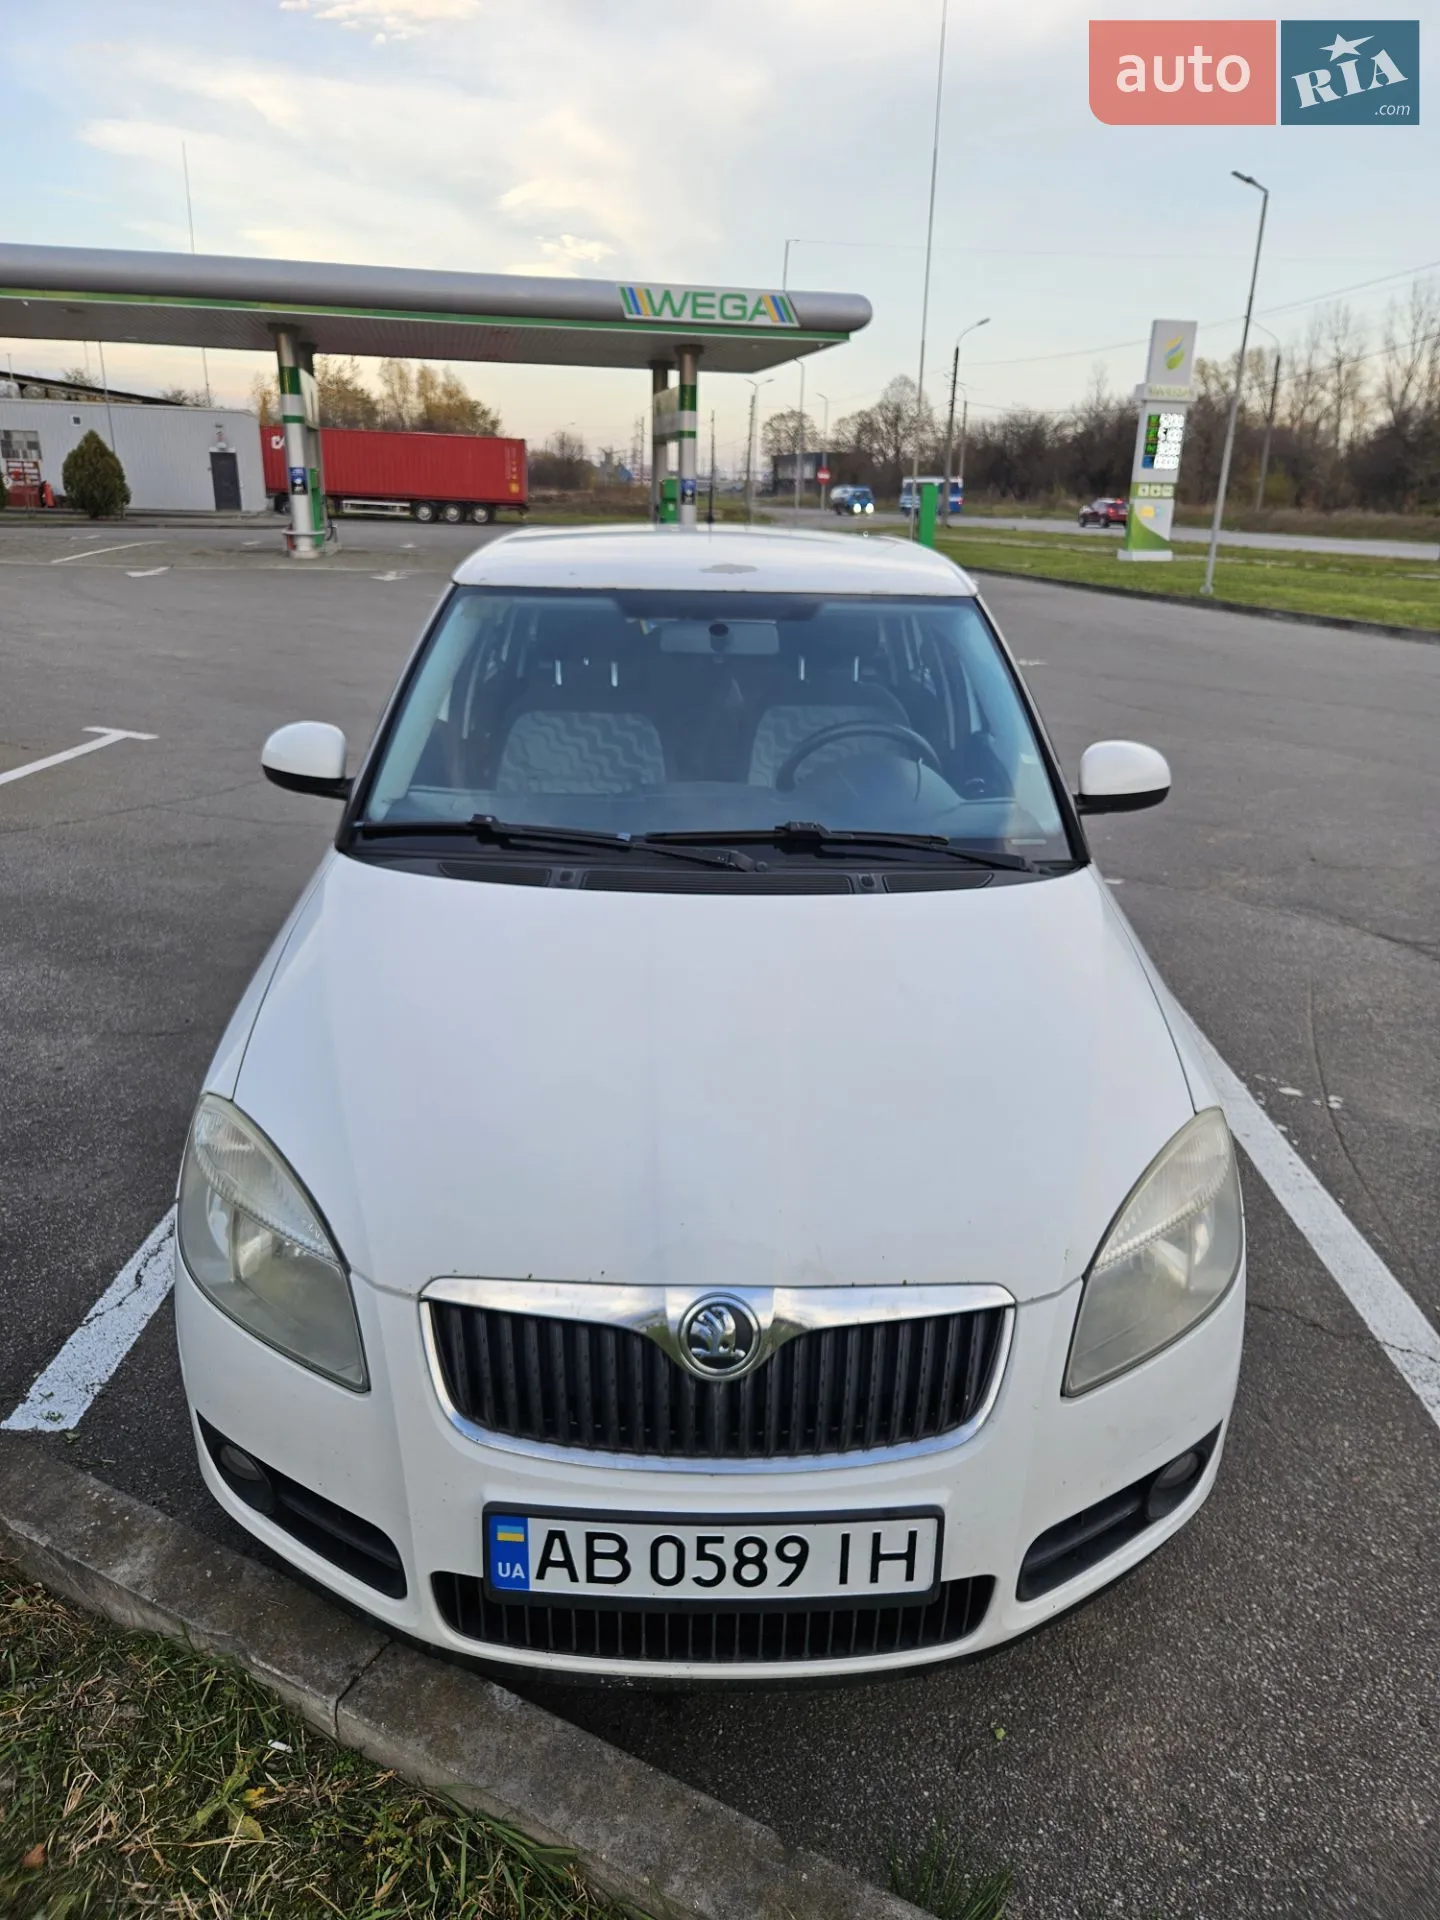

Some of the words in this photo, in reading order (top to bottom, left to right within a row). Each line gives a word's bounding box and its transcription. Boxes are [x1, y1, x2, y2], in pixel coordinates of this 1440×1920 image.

[644, 288, 779, 324] WEGA
[497, 1562, 526, 1580] UA
[535, 1529, 632, 1585] AB
[649, 1534, 810, 1588] 0589
[838, 1530, 919, 1586] IH
